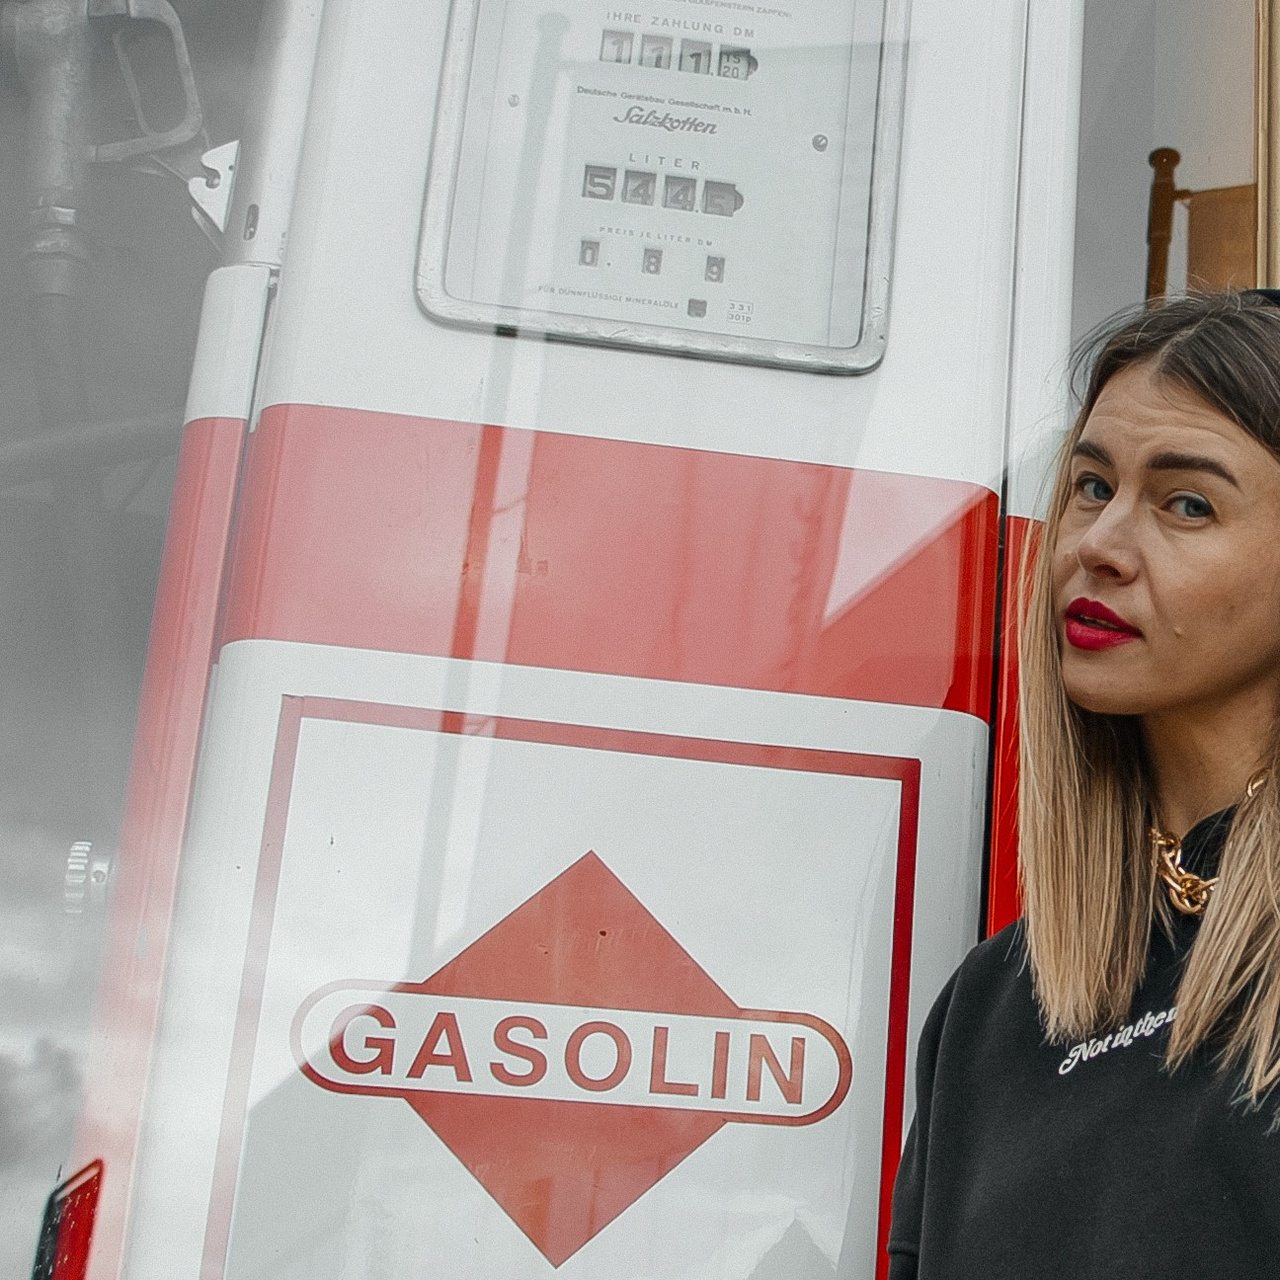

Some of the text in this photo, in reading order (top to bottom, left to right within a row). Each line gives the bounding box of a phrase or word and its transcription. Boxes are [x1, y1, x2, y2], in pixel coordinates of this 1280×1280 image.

[606, 11, 755, 38] IHRE ZAHLUNG DM
[577, 85, 617, 98] Deutsche
[668, 97, 721, 112] Gesellschaft
[613, 106, 718, 135] Salzkotten
[629, 152, 700, 170] LITER
[600, 226, 635, 237] PREIS
[657, 233, 691, 243] LITER
[697, 238, 713, 247] DM
[329, 1004, 806, 1105] GASOLIN
[1058, 1034, 1113, 1075] Not
[1111, 1025, 1134, 1048] in
